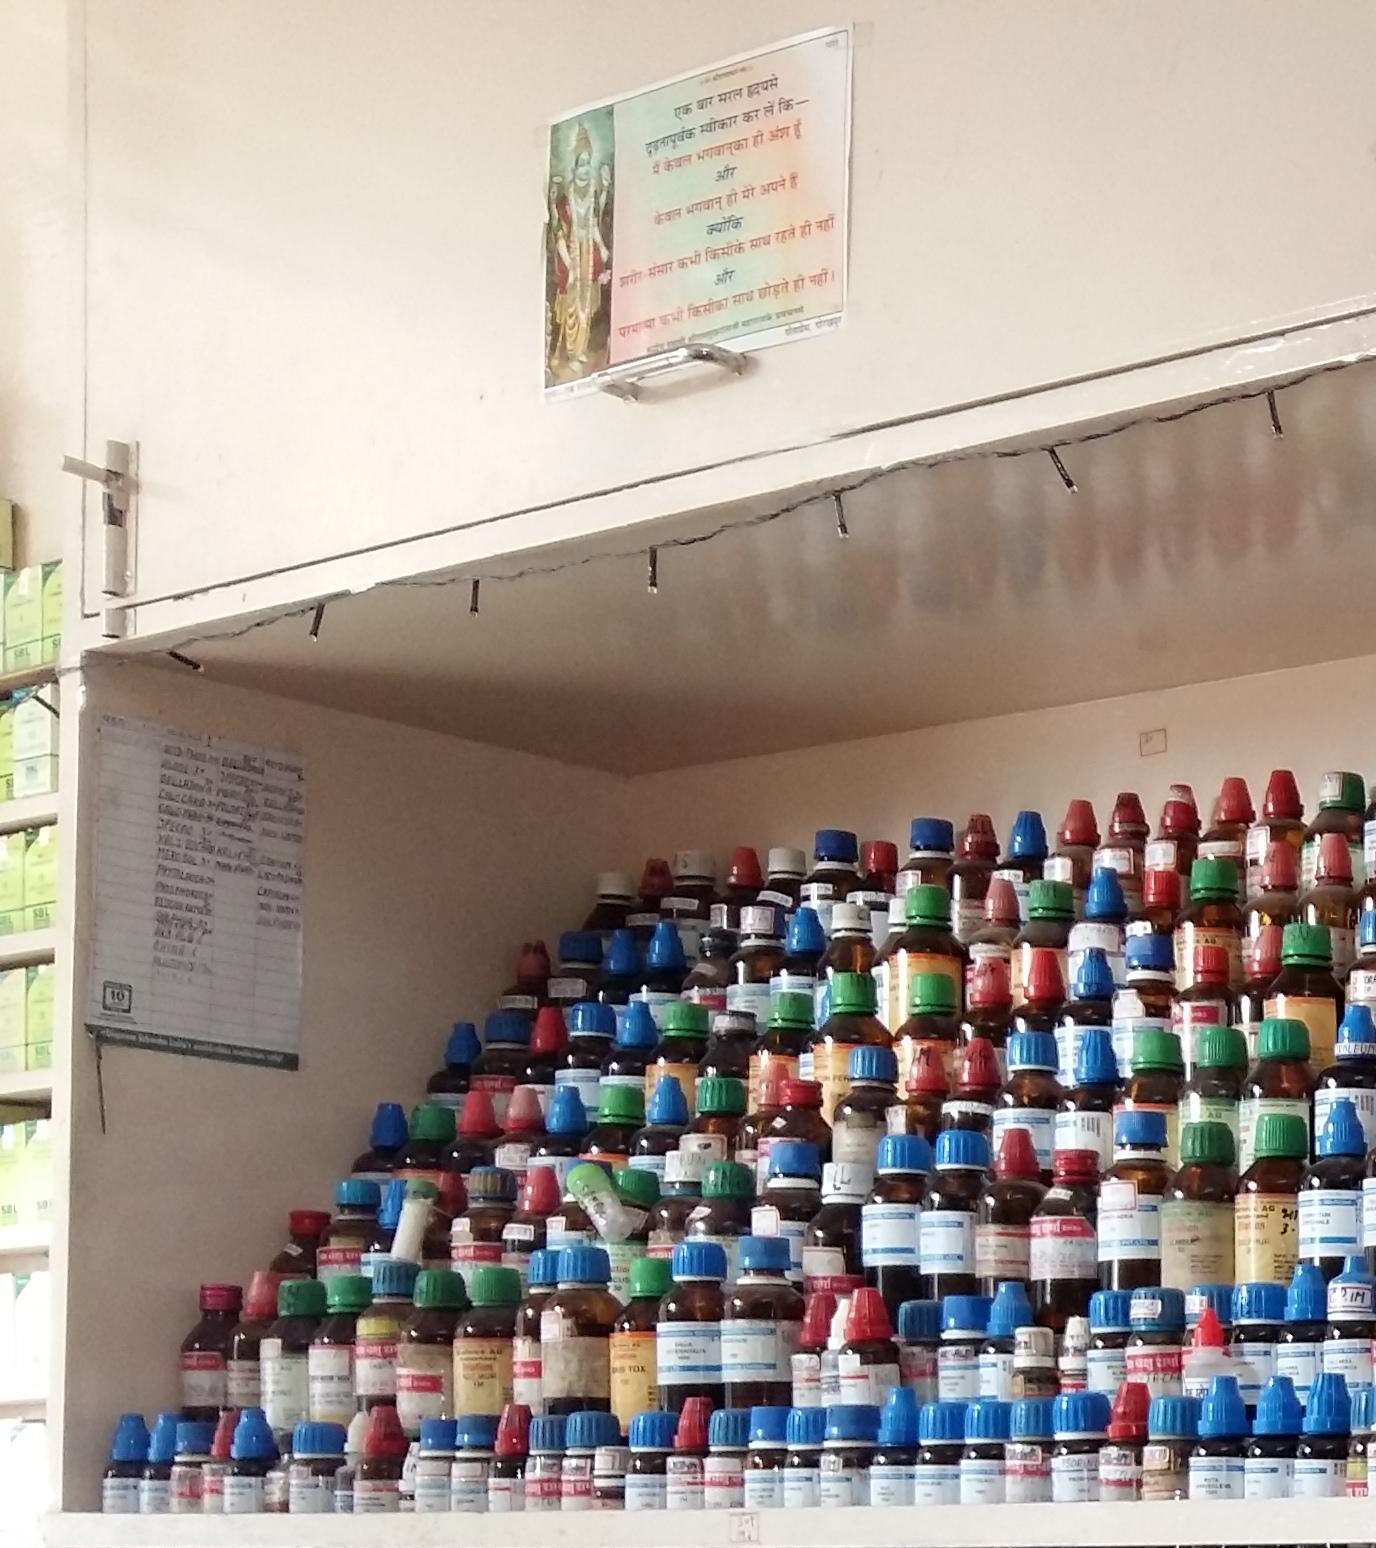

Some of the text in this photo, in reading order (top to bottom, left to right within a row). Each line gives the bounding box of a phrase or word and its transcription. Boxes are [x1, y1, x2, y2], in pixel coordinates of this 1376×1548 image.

[674, 105, 693, 122] एक
[742, 108, 759, 123] कर
[715, 165, 737, 182] और
[706, 215, 744, 235] क्योंकि
[714, 270, 736, 286] और
